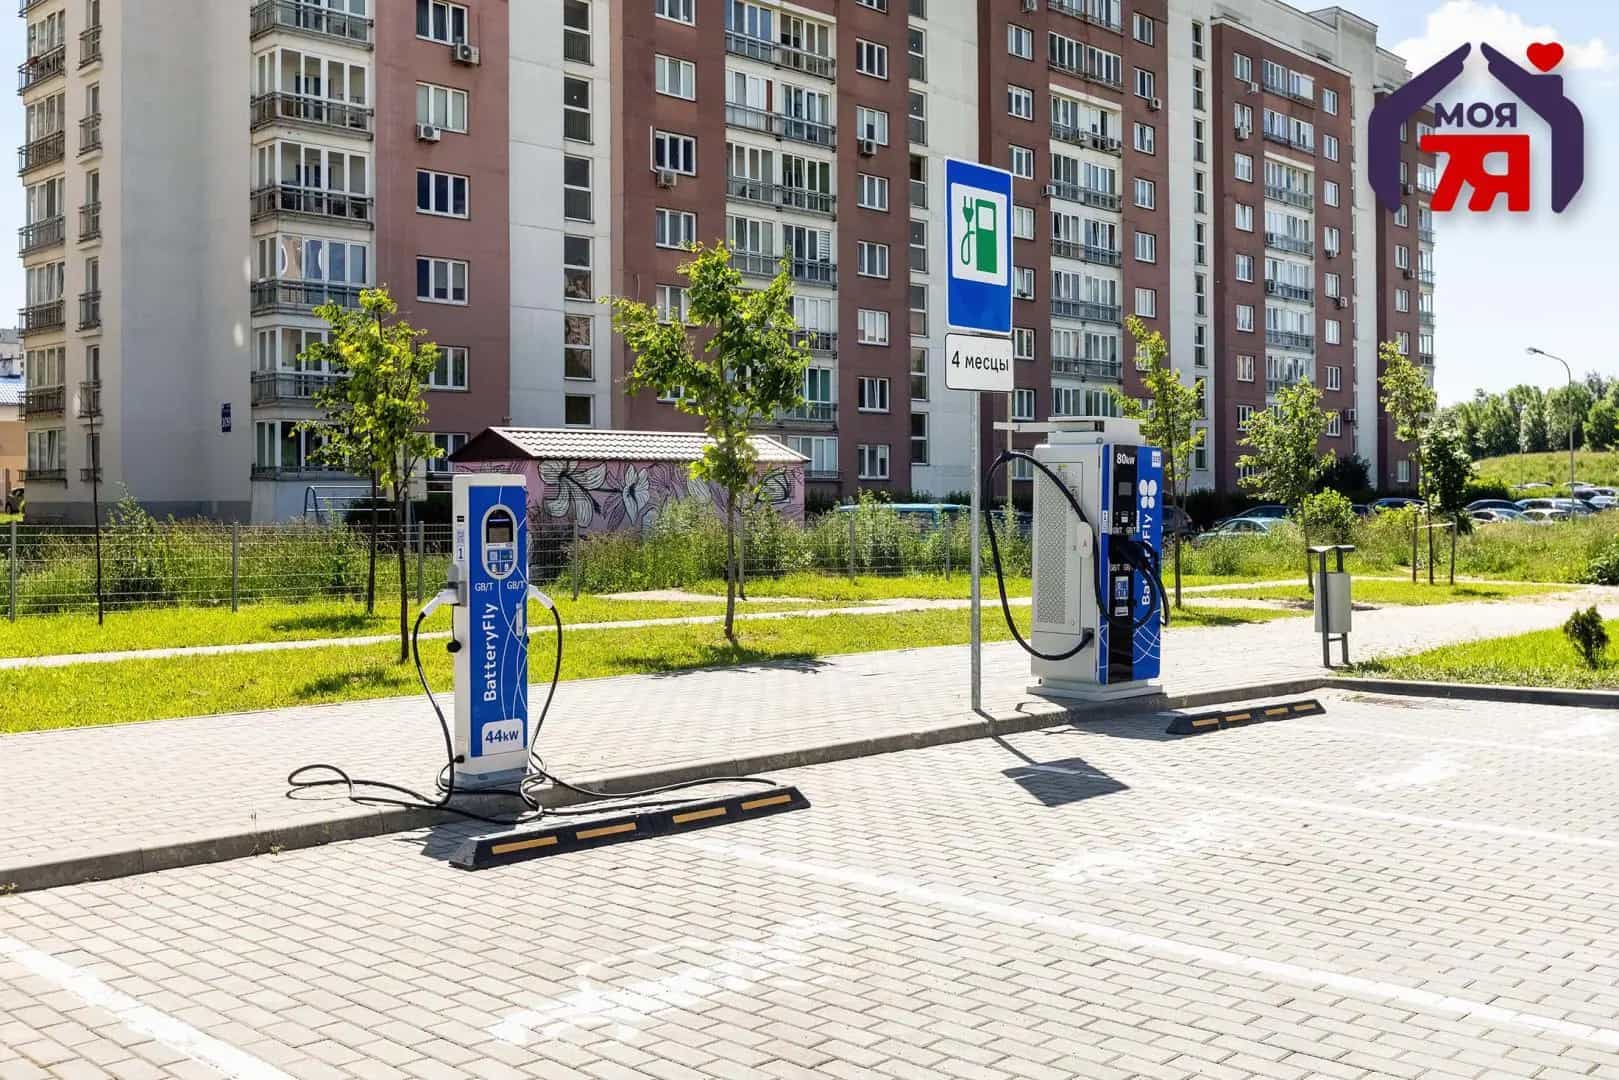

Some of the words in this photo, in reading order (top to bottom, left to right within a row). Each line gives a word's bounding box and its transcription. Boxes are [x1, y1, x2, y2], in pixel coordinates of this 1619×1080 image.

[951, 350, 961, 368] 4
[965, 355, 1009, 373] месцы
[474, 582, 494, 593] GB/T
[506, 580, 525, 591] GB/T
[482, 603, 499, 702] BatteryFly
[485, 729, 519, 744] 44kW
